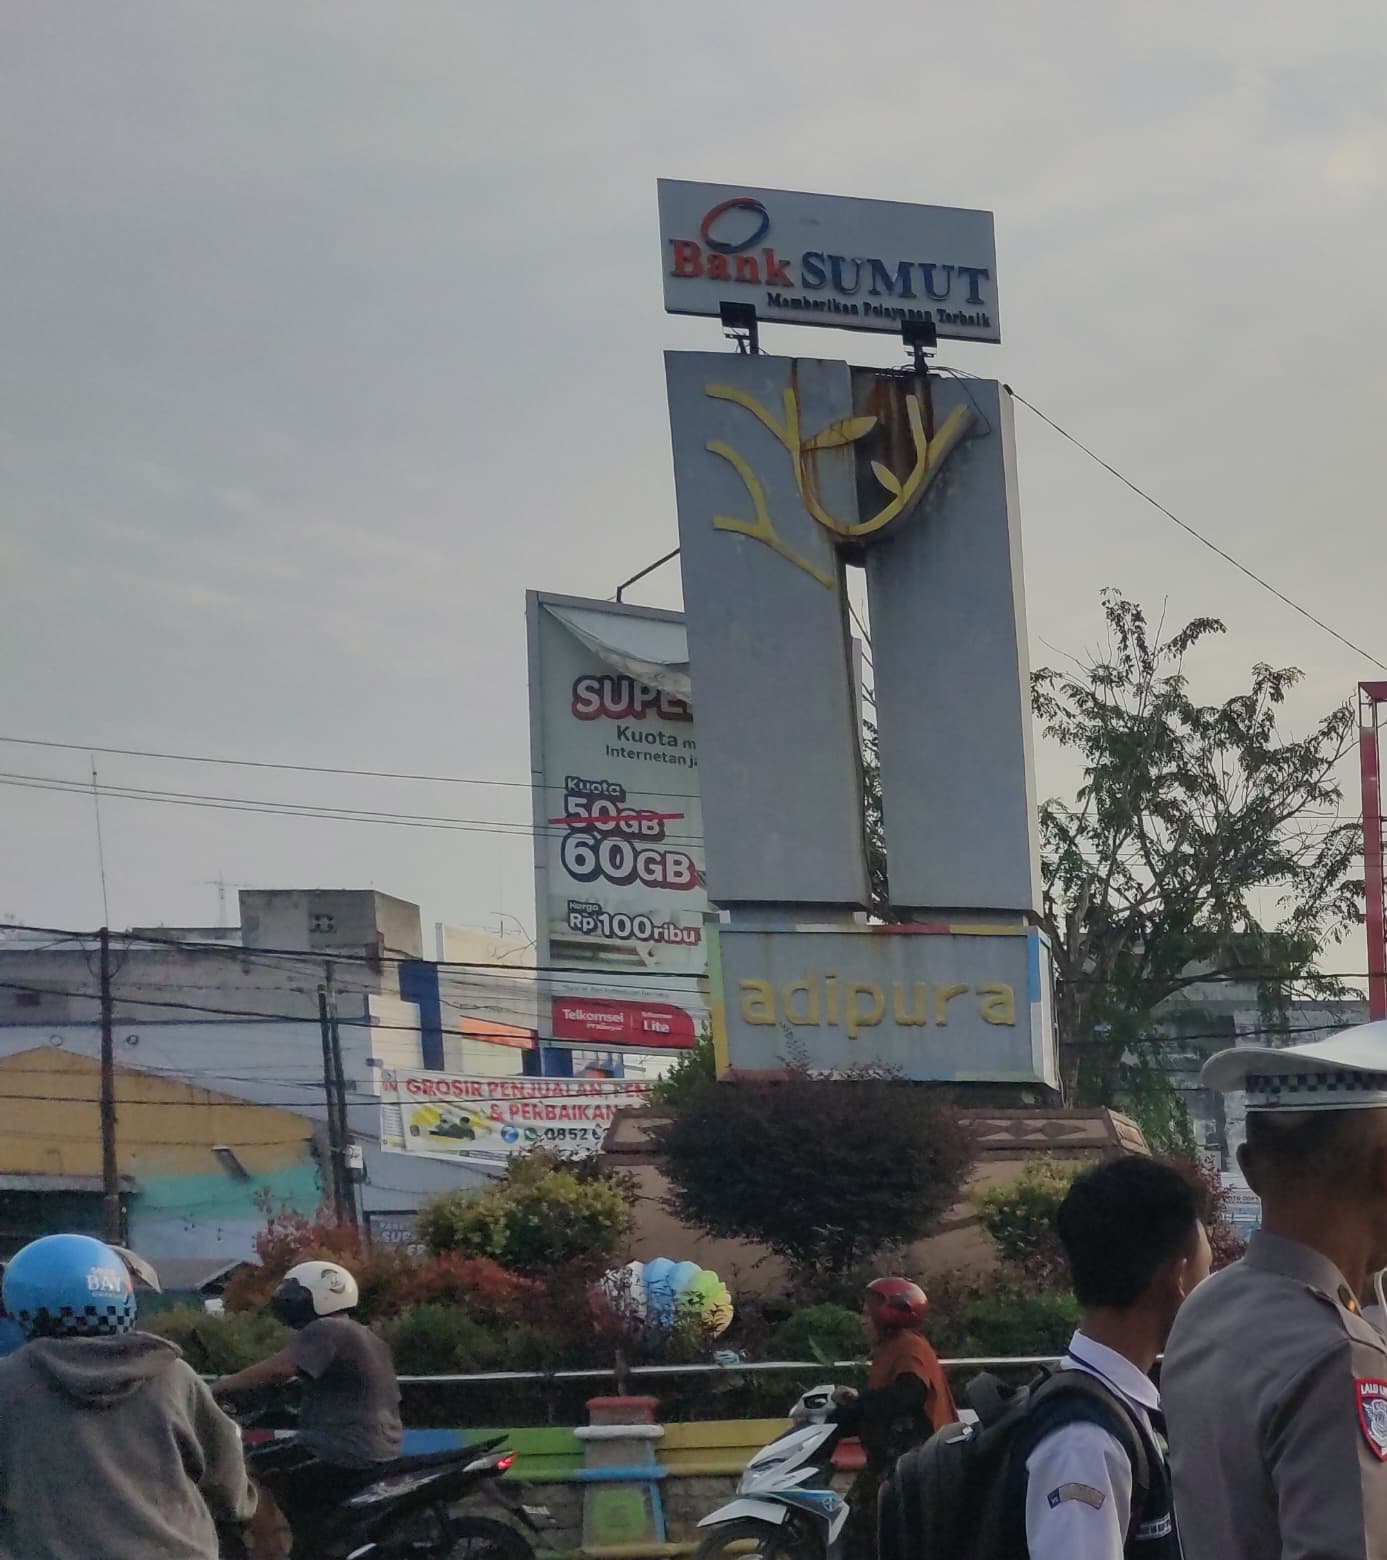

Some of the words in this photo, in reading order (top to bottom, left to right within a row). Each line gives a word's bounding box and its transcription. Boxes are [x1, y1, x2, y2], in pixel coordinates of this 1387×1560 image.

[669, 239, 794, 287] Bank
[801, 251, 990, 305] SUMUT
[766, 292, 859, 315] Memberikan
[936, 308, 991, 328] Terbaik
[616, 724, 678, 747] Kuota
[606, 744, 686, 766] Internetan
[566, 776, 622, 797] Kuota
[566, 796, 662, 836] 50GB
[563, 832, 692, 884] 60GB
[562, 1009, 624, 1023] Telkomsel
[738, 971, 1016, 1039] adipura
[643, 1020, 670, 1033] Lite
[406, 1079, 483, 1097] GROSIR
[490, 1104, 504, 1121] &
[508, 1103, 618, 1121] PERBAIKAN
[545, 1127, 588, 1141] 0852
